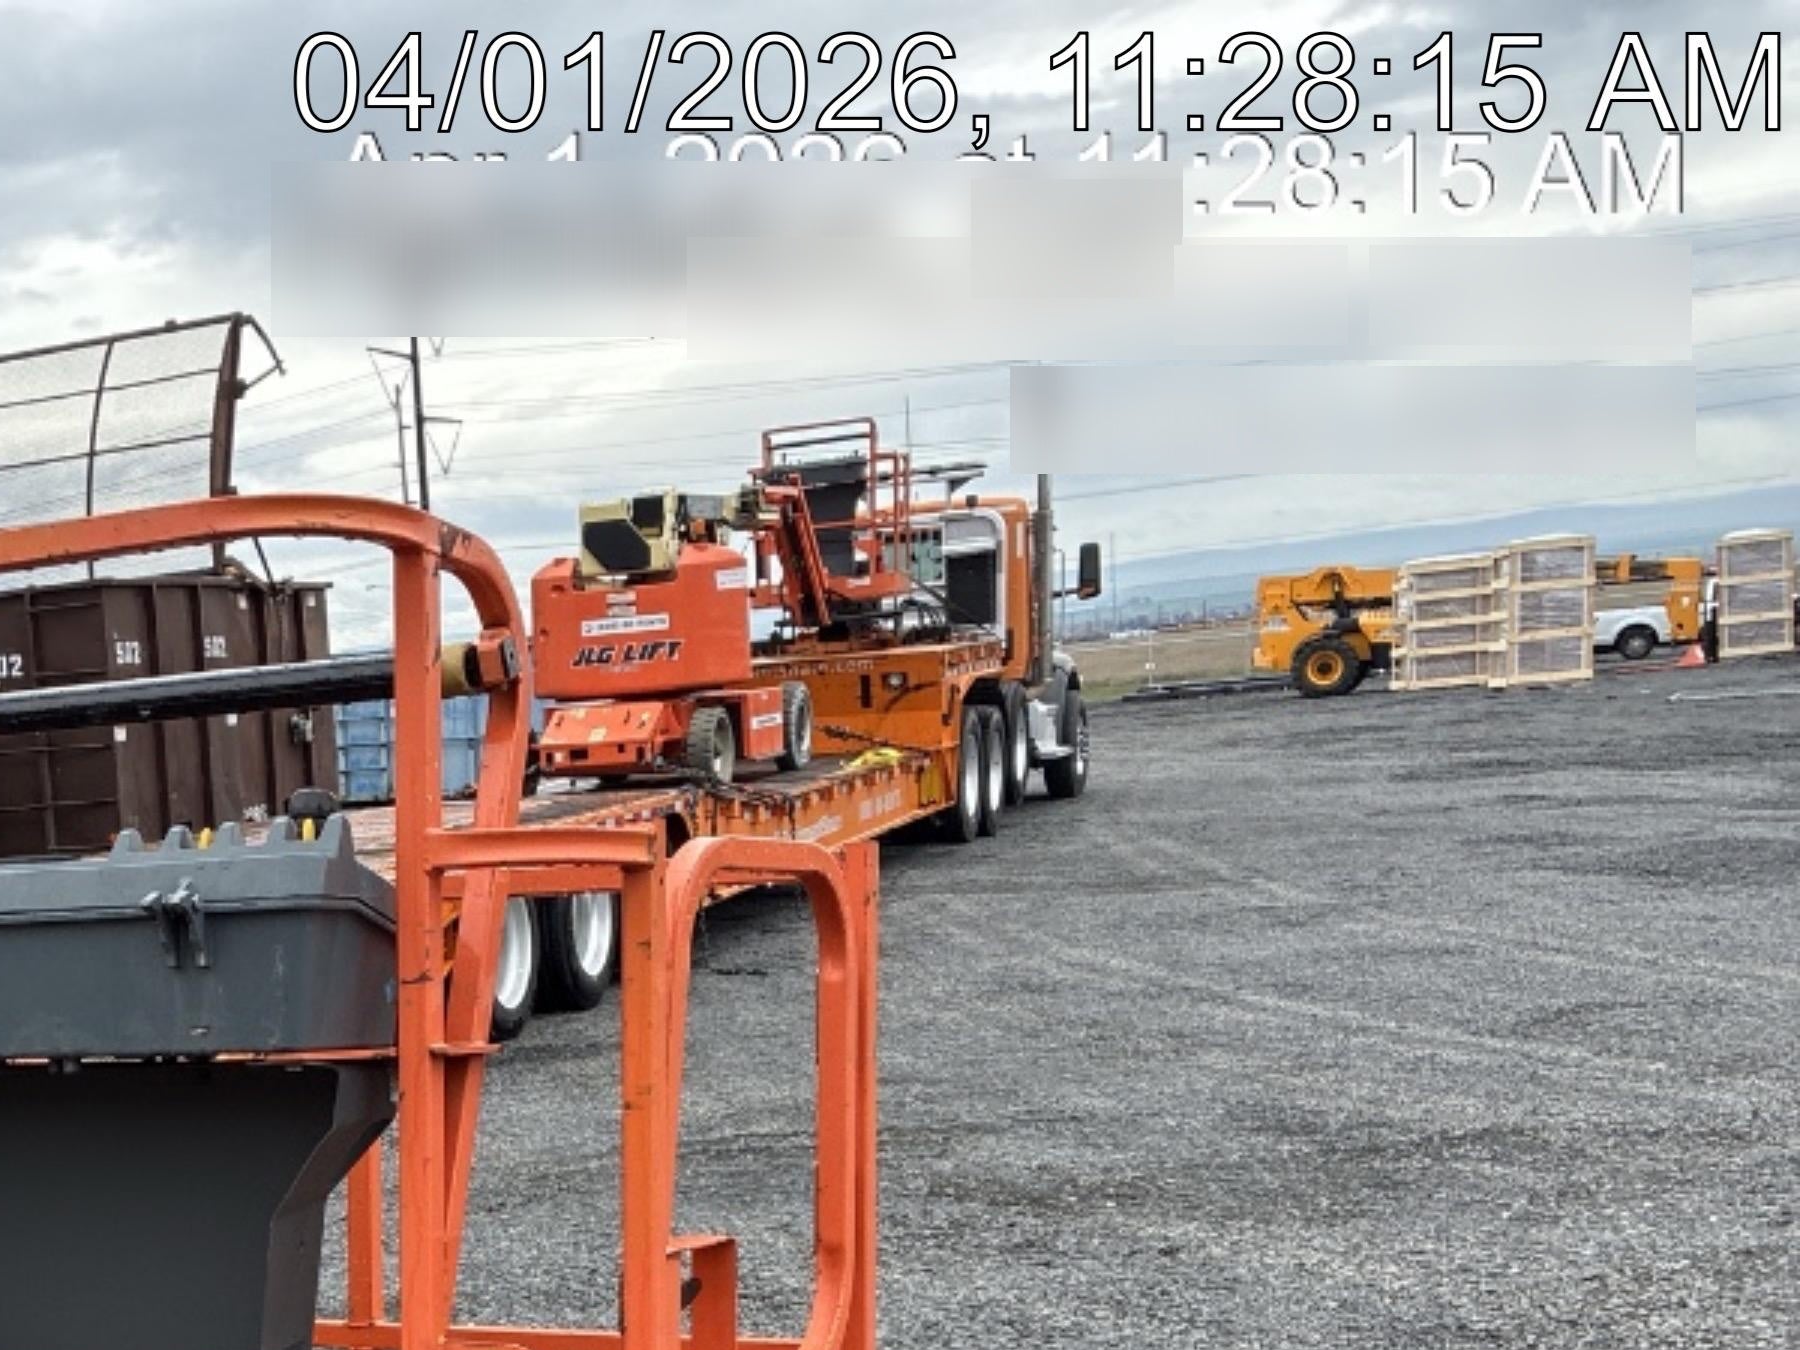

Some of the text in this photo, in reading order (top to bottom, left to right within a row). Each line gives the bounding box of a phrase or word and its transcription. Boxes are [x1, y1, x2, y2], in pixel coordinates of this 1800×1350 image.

[116, 641, 141, 665] 502
[571, 639, 684, 668] JLG LIFT
